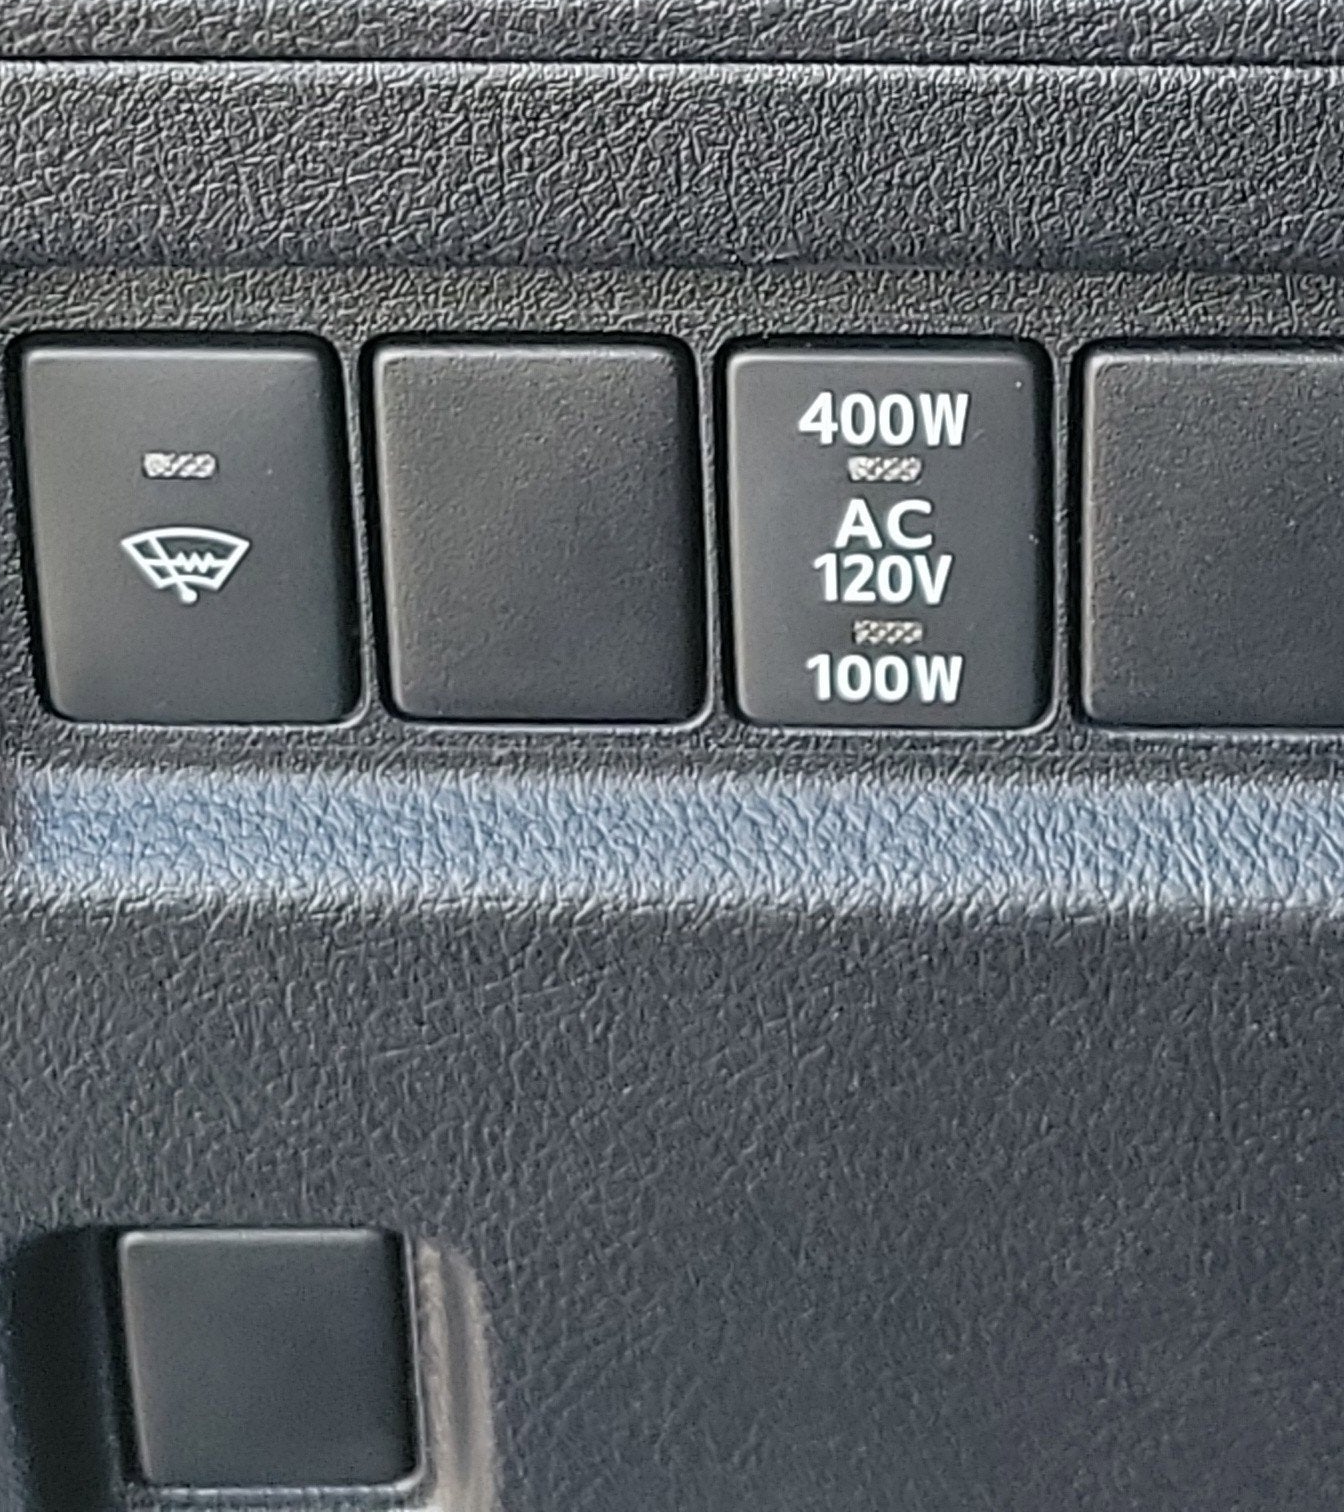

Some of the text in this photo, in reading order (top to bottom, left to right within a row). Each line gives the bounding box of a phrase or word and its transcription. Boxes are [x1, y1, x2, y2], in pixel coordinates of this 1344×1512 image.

[797, 391, 969, 447] 400W
[833, 497, 934, 550] AC
[812, 551, 953, 605] 120V
[805, 652, 964, 703] 100W
